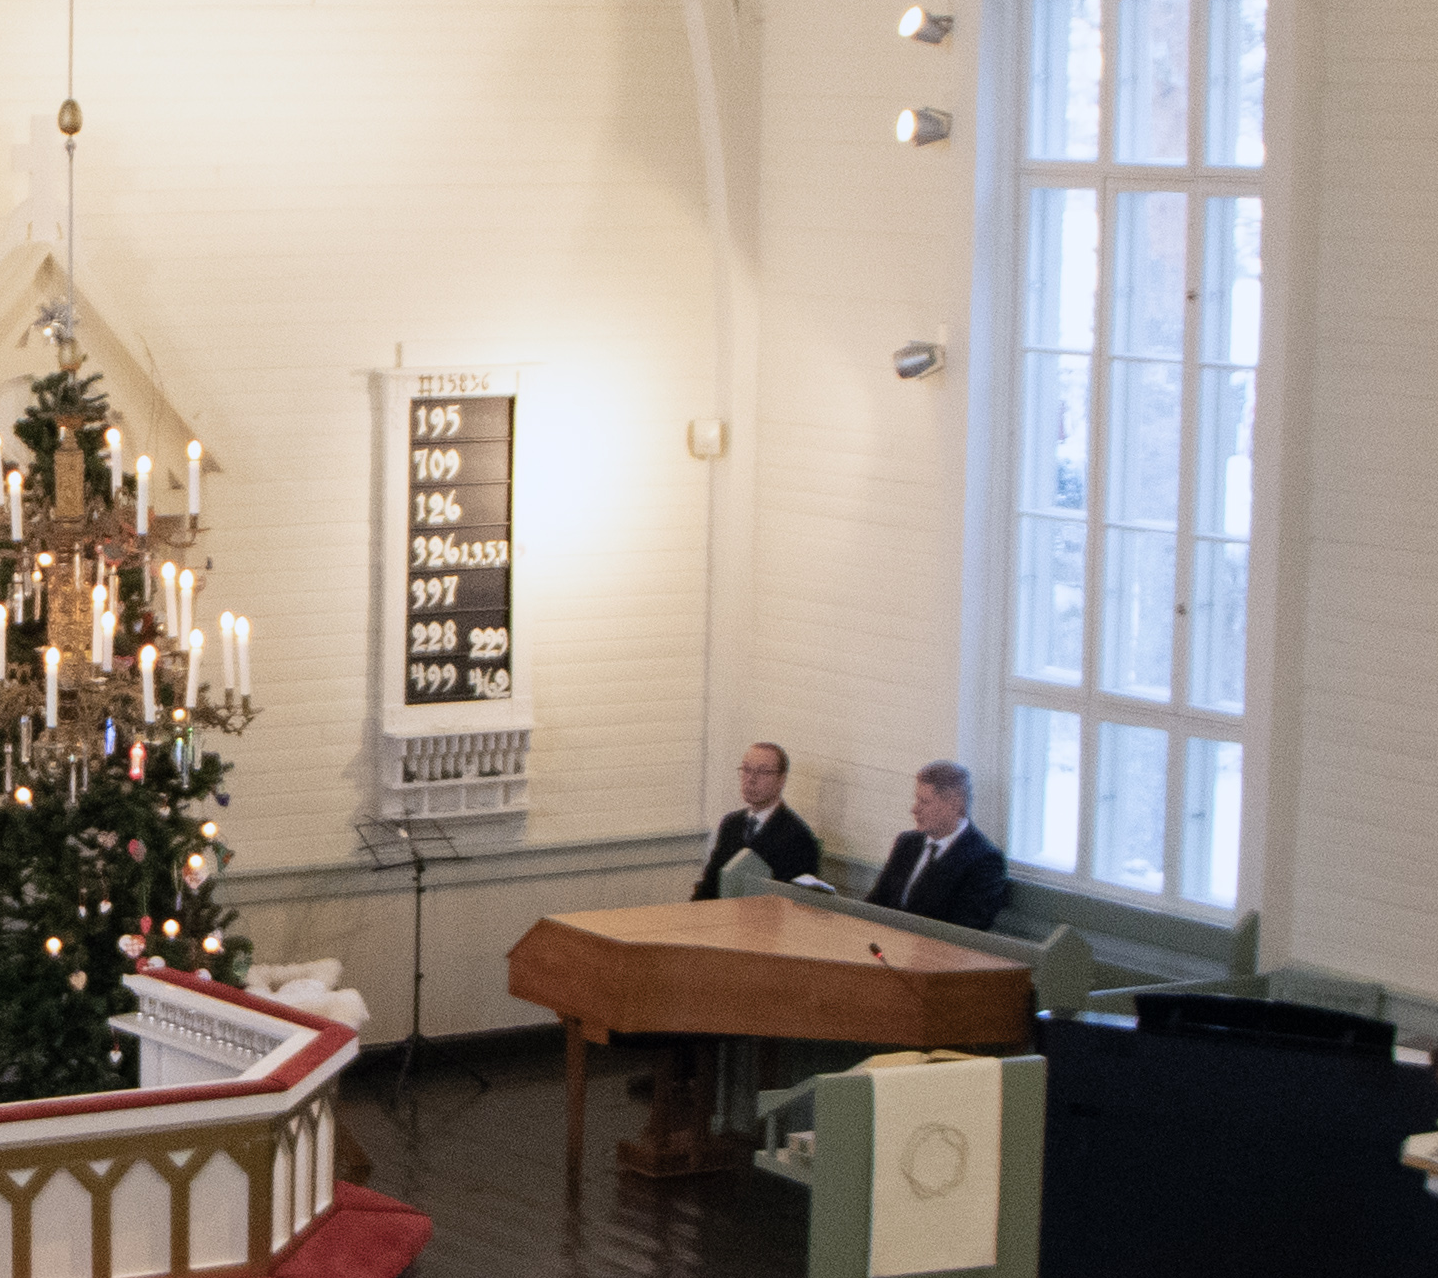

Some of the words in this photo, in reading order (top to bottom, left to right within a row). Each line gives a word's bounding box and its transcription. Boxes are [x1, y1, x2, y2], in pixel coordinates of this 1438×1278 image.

[416, 404, 461, 438] 195
[414, 448, 460, 480] 709
[415, 489, 462, 524] 126
[413, 533, 459, 567] 326
[412, 575, 459, 609] 397
[411, 619, 457, 653] 228
[469, 626, 508, 658] 229
[410, 662, 457, 694] 499
[468, 667, 512, 699] 462
